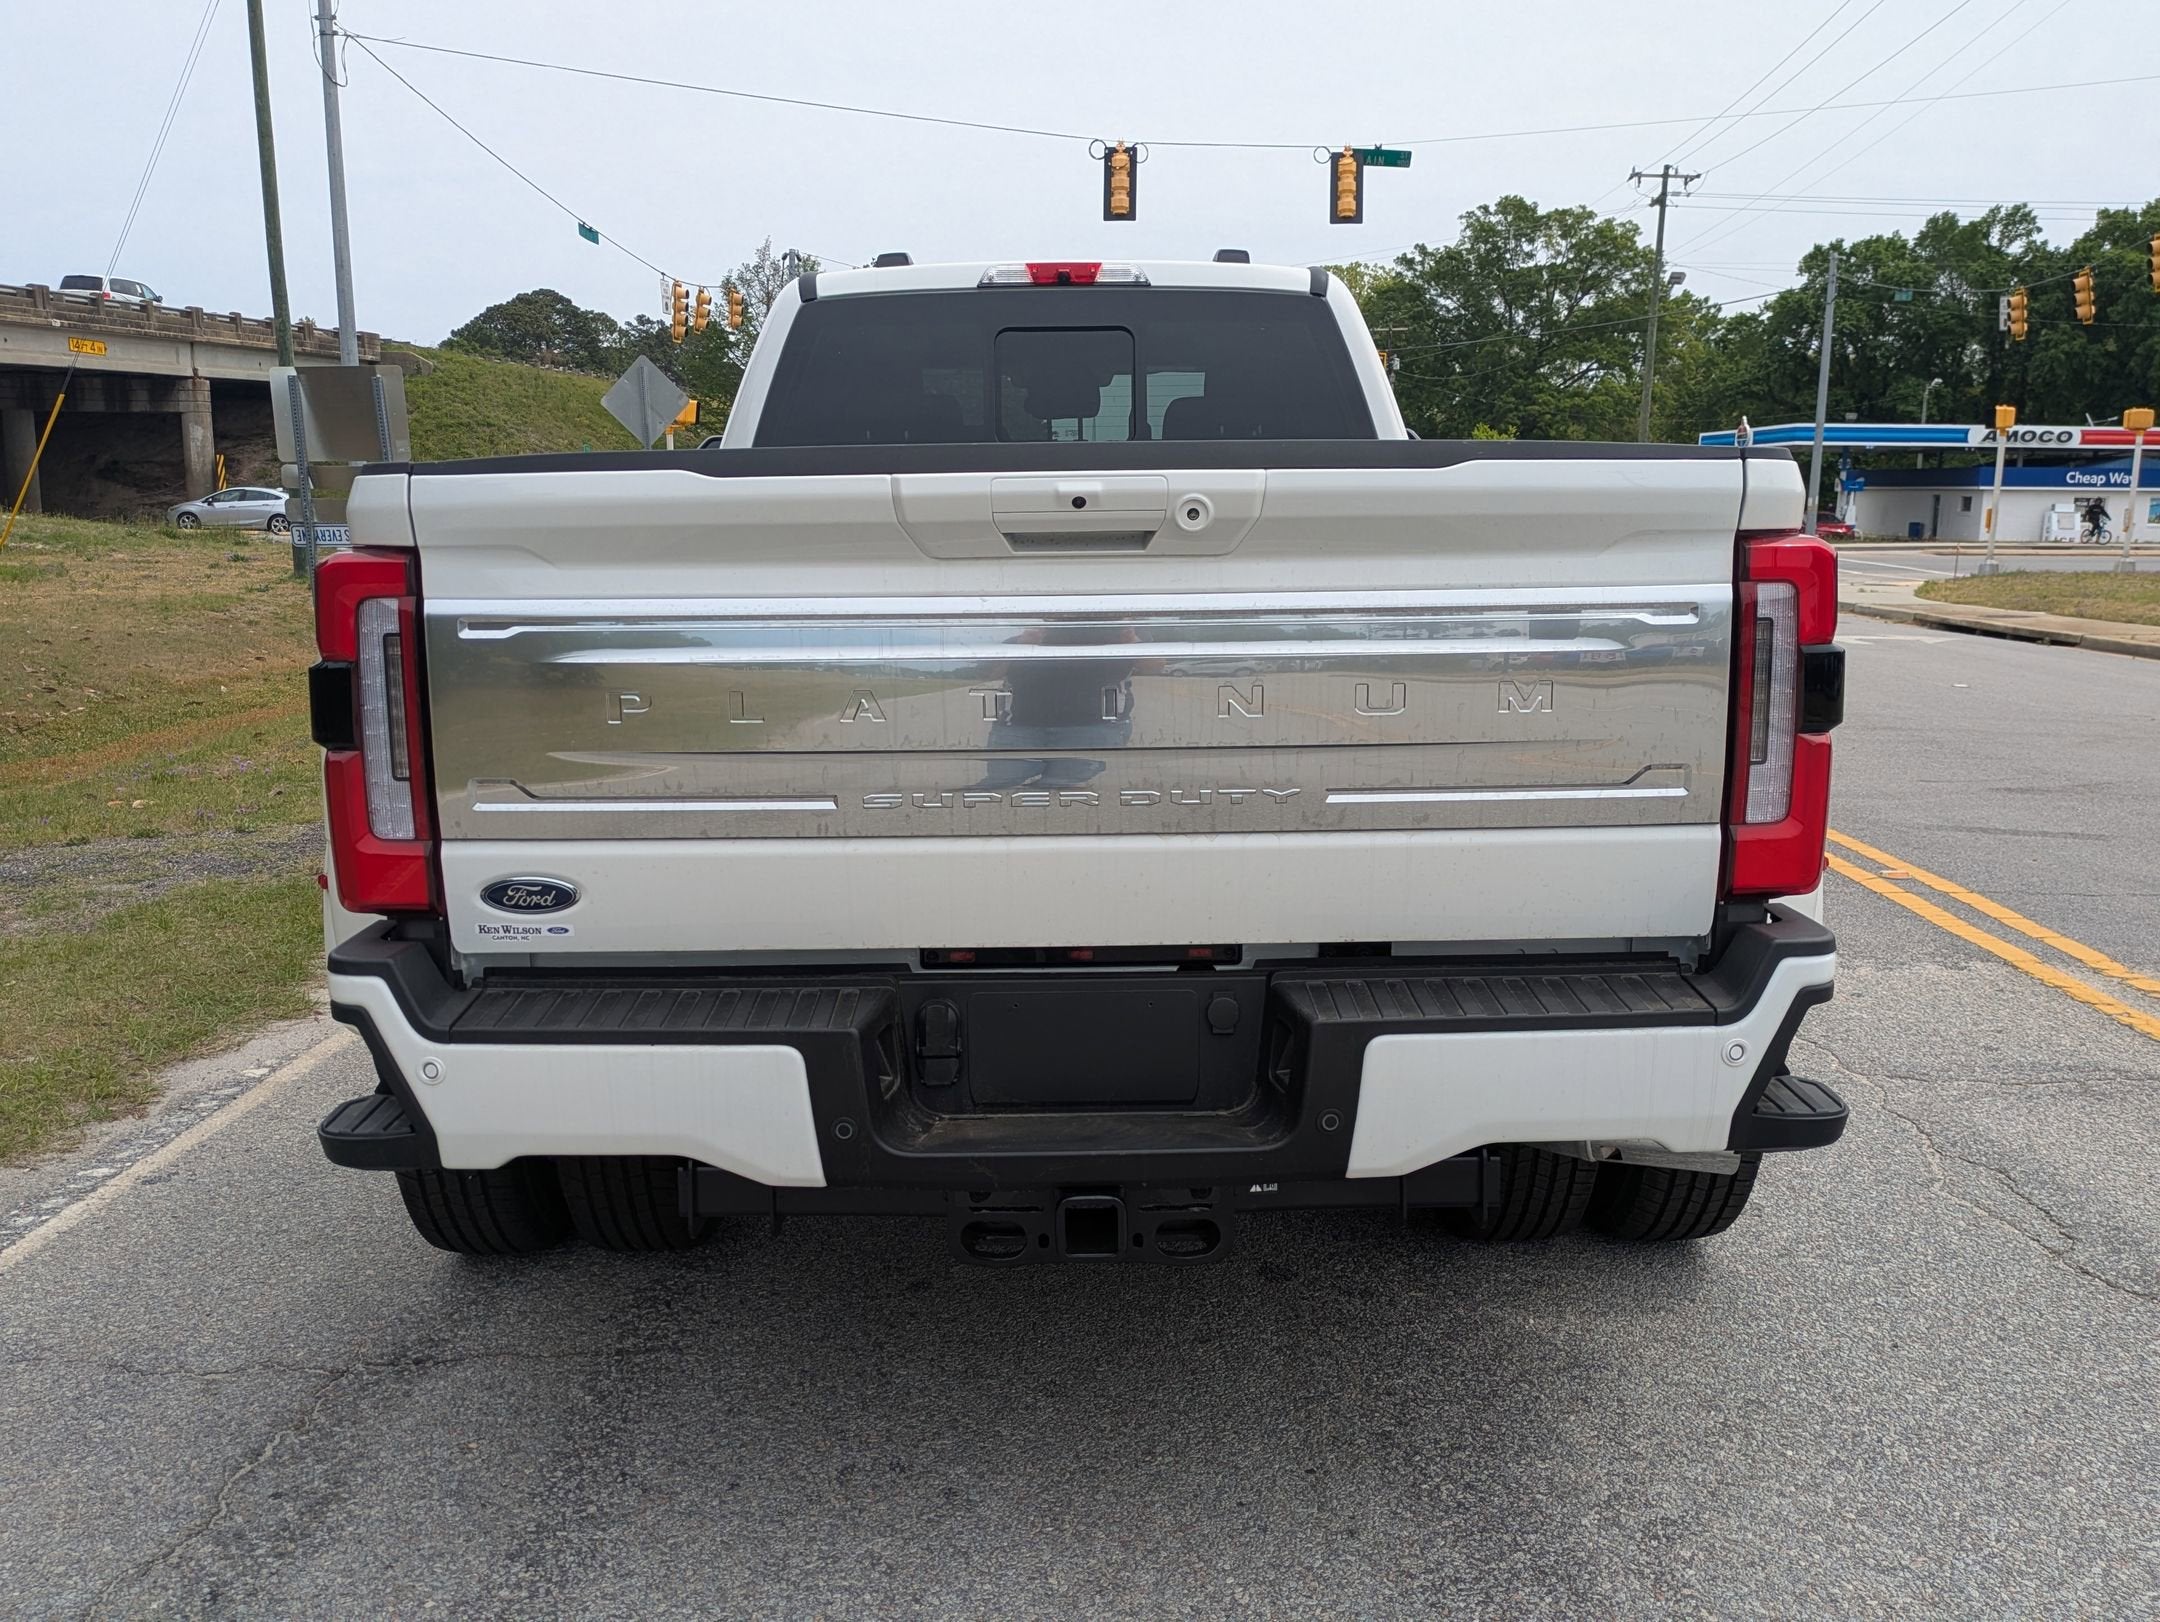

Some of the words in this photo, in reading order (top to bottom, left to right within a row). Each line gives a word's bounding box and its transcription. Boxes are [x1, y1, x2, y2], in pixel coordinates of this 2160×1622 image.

[1365, 154, 1385, 166] AIN
[1982, 429, 2073, 444] AMOCO
[2065, 471, 2106, 487] Cheap
[2109, 472, 2133, 484] Wa
[295, 529, 343, 542] EVERYNE
[606, 680, 1555, 723] PLATINUM
[862, 791, 1100, 809] SUPER
[1119, 788, 1301, 807] DUTY
[503, 885, 556, 906] Ford
[478, 924, 500, 935] KEN
[500, 925, 542, 935] WILSON
